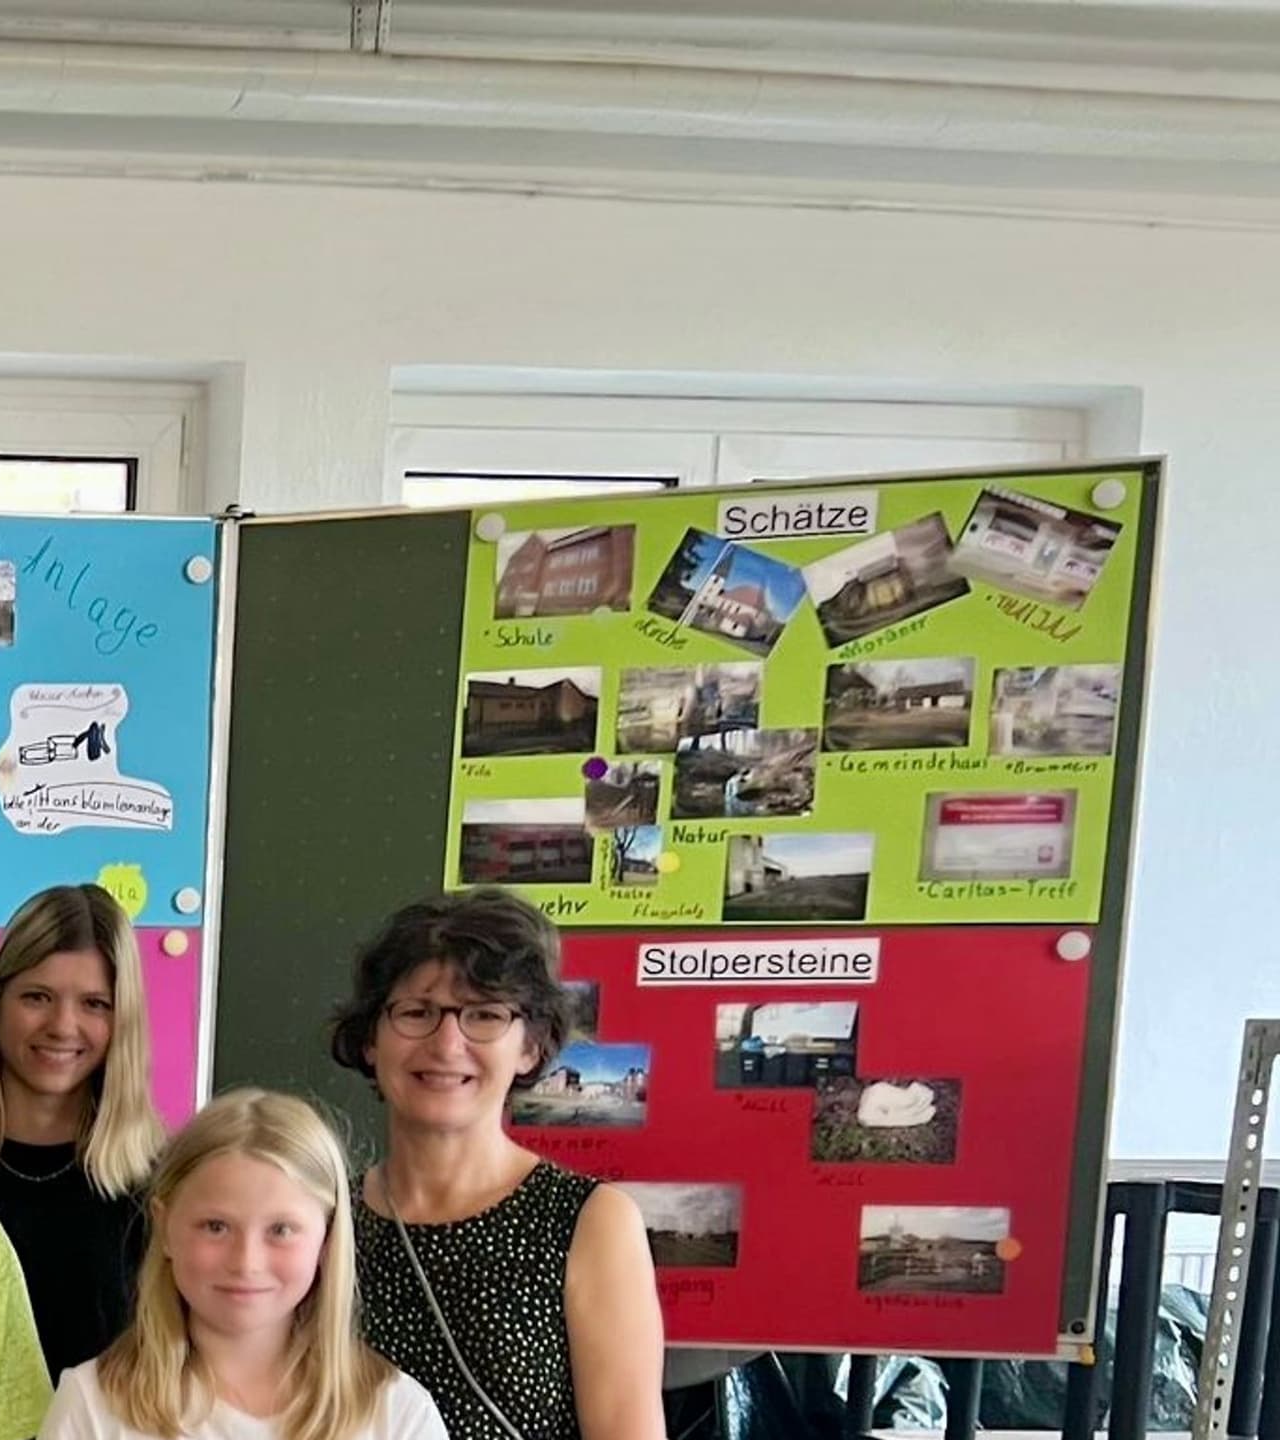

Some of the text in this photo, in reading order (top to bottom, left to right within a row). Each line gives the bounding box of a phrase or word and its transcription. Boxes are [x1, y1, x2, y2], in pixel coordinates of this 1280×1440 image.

[724, 504, 869, 534] Schätze
[672, 826, 728, 845] Natur
[927, 879, 1078, 900] Caritas-Treff
[643, 948, 873, 980] Stolpersteine
